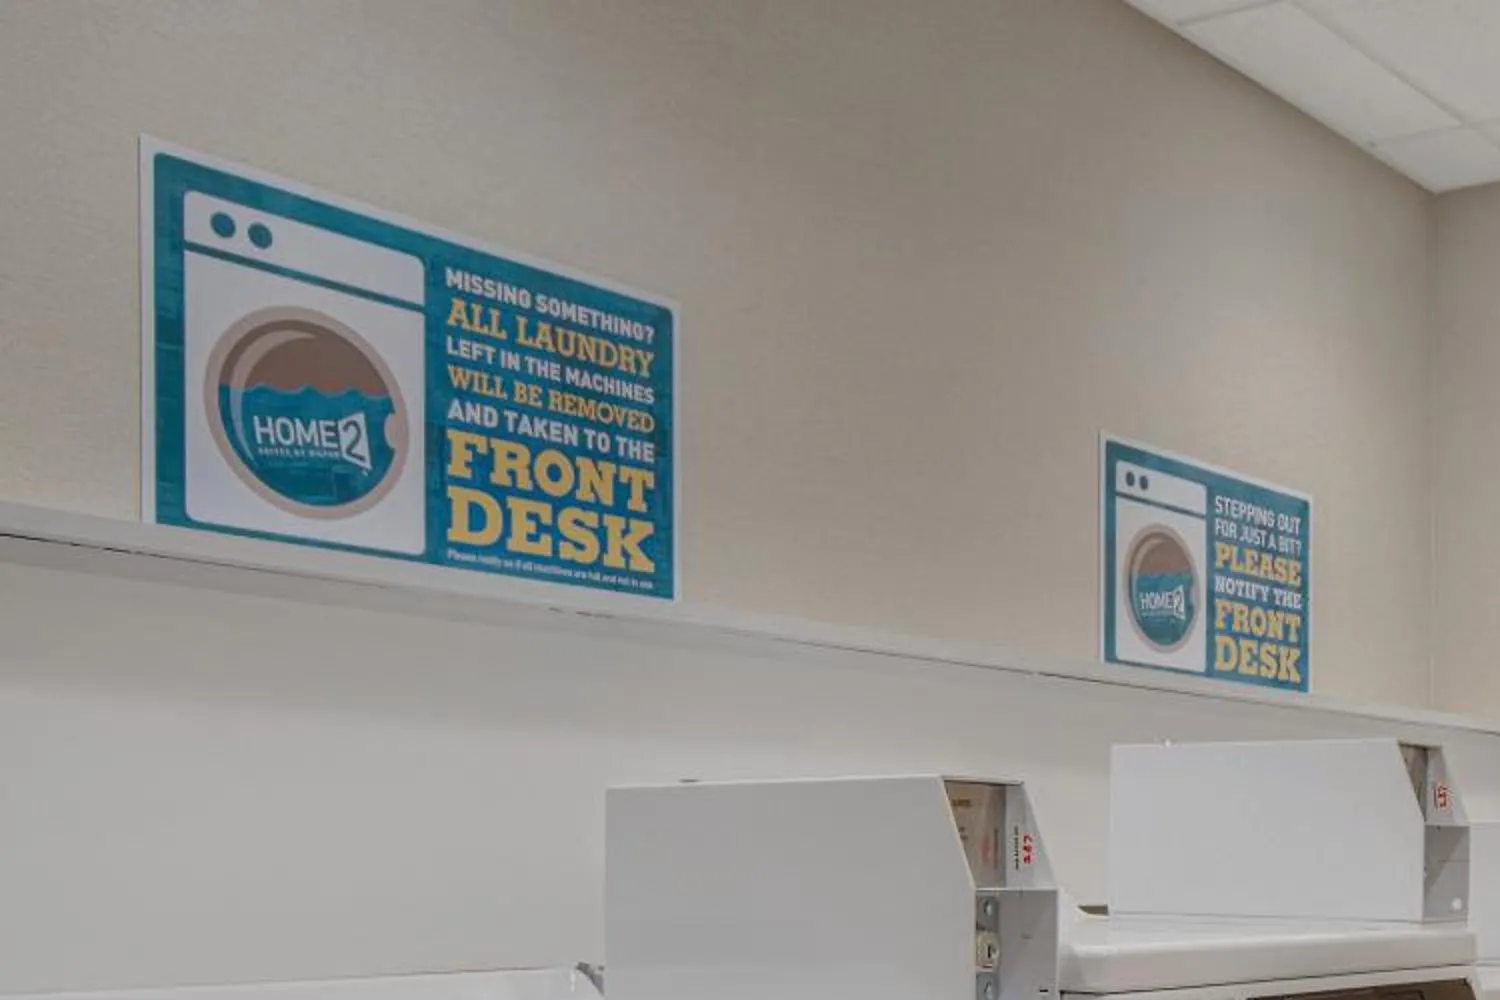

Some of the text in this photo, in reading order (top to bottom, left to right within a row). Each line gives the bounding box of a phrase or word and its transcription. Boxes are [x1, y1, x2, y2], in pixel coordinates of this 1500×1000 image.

[445, 267, 655, 344] MISSING SOMETHING?
[447, 297, 655, 378] ALL LAUNDRY
[446, 335, 655, 405] LEFT IN THE MACHINES
[447, 364, 655, 432] WILL BE REMOVED
[447, 397, 655, 463] AND TAKEN TO THE
[447, 428, 655, 513] FRONT
[447, 485, 655, 573] DESK
[1215, 495, 1301, 535] STEPPING OUT
[1215, 517, 1237, 540] FOR
[1240, 524, 1267, 548] JUST
[1267, 533, 1277, 551] A
[1215, 541, 1301, 587] PLEASE
[1215, 574, 1302, 609] NOTIFY THE
[1215, 598, 1301, 643] FRONT
[1215, 635, 1301, 684] DESK
